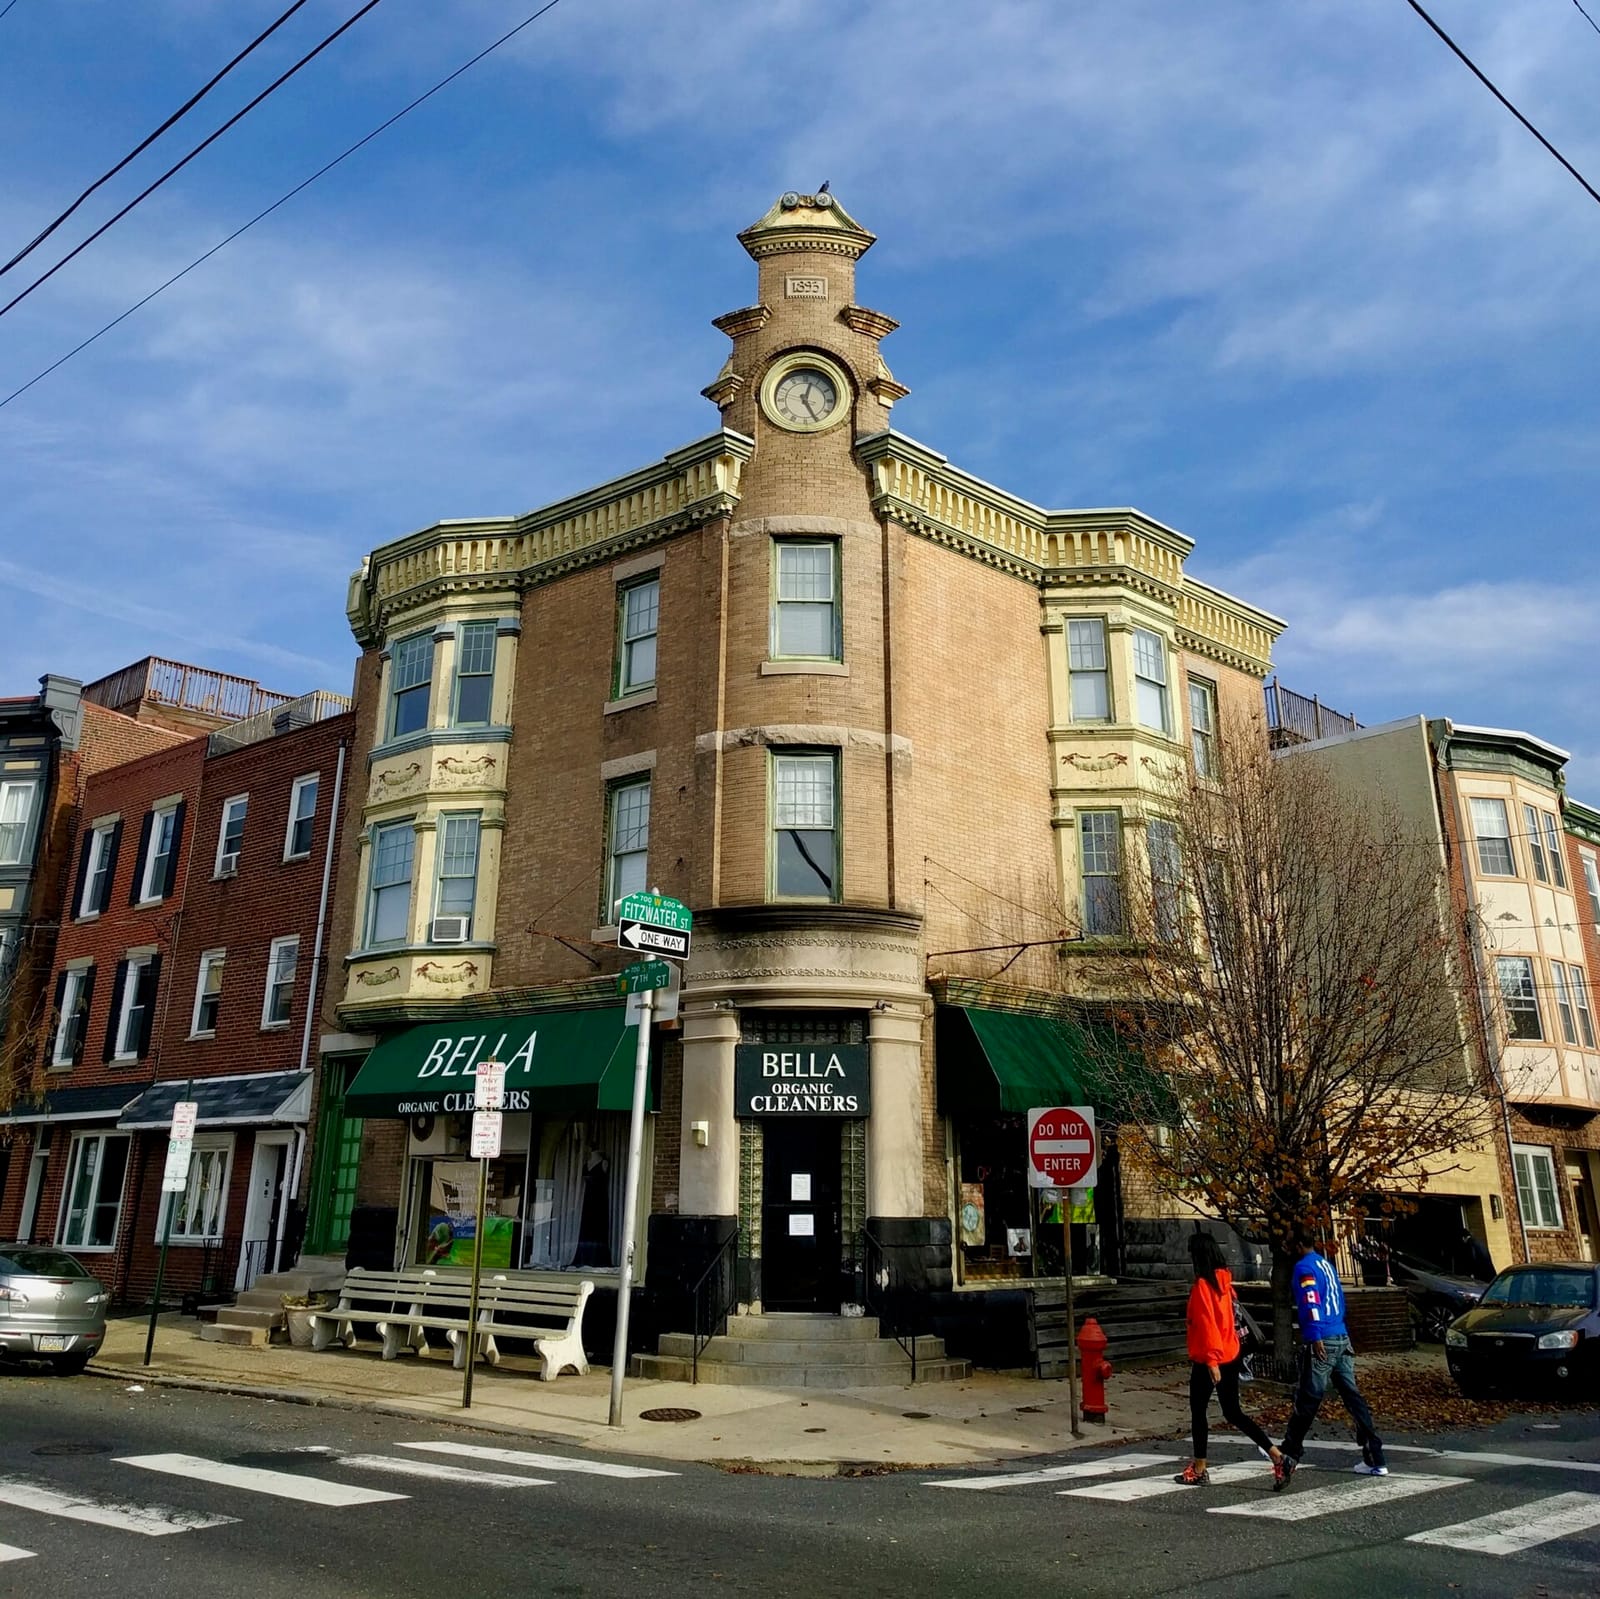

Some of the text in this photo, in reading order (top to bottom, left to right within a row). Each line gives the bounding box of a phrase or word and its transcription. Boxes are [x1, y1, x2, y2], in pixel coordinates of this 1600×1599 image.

[624, 902, 688, 929] FITZWATER ST
[640, 931, 682, 949] ONE WAY
[632, 974, 667, 992] 7TH ST
[762, 1053, 846, 1078] BELLA
[772, 1083, 834, 1095] ORGANIC
[398, 1090, 530, 1113] ORGANIC CLEERS
[750, 1095, 858, 1112] CLEANERS
[1039, 1123, 1084, 1136] DO NOT
[1044, 1158, 1080, 1170] ENTER
